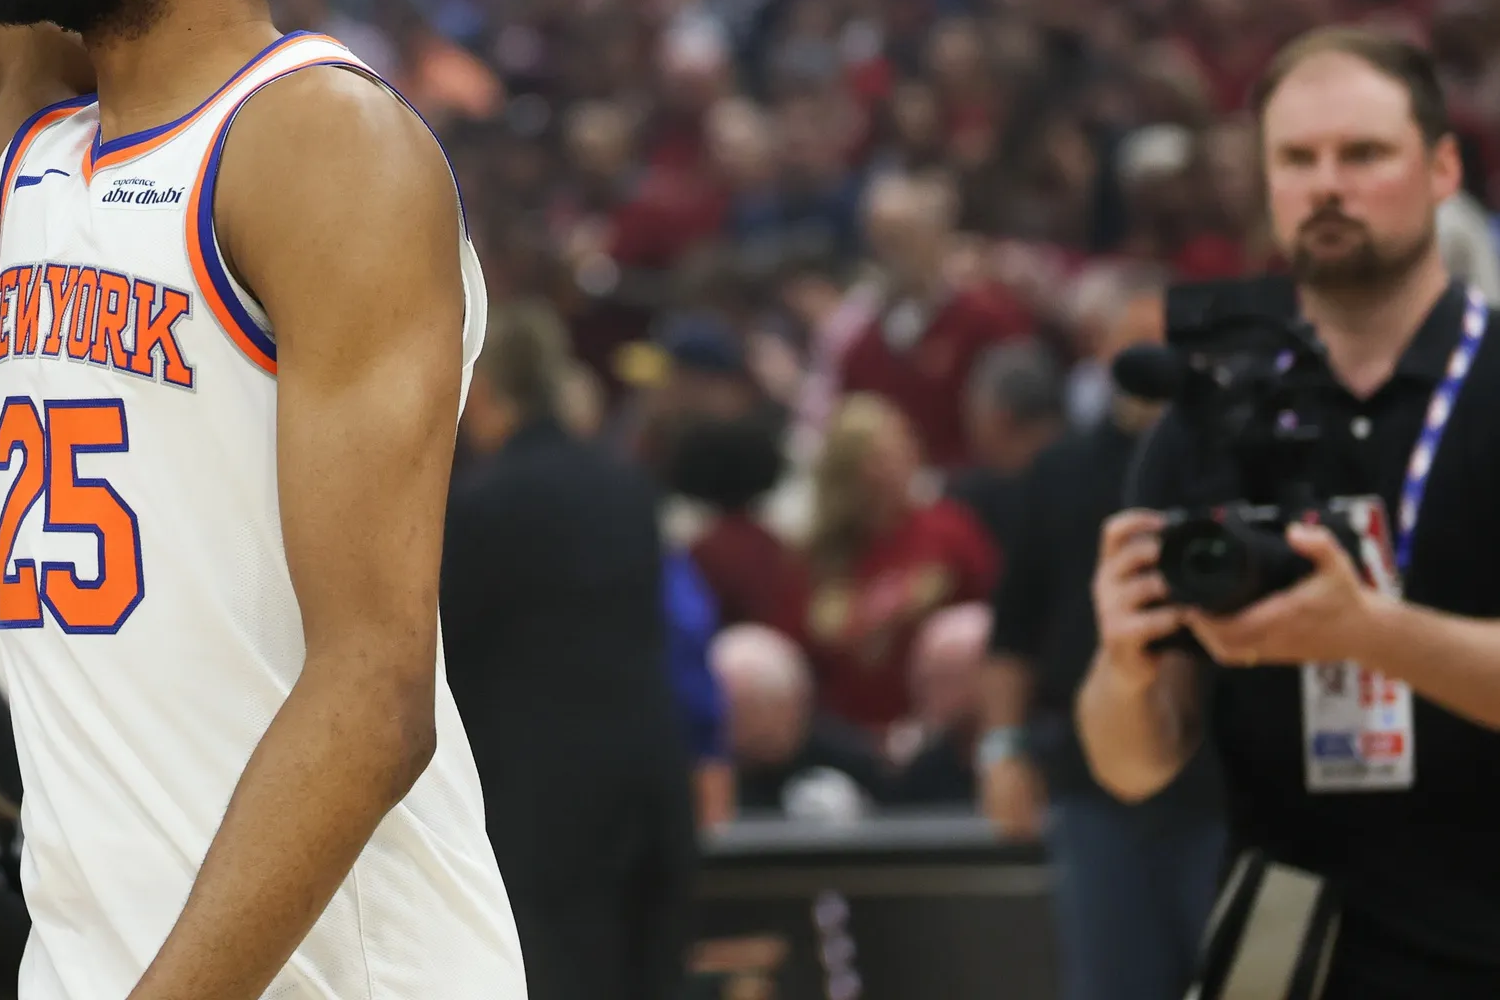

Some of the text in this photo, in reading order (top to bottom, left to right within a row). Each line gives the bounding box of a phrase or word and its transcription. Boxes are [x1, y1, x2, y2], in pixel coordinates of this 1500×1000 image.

[113, 176, 156, 187] experience
[102, 186, 185, 205] abu dhabi
[40, 260, 196, 393] YORK
